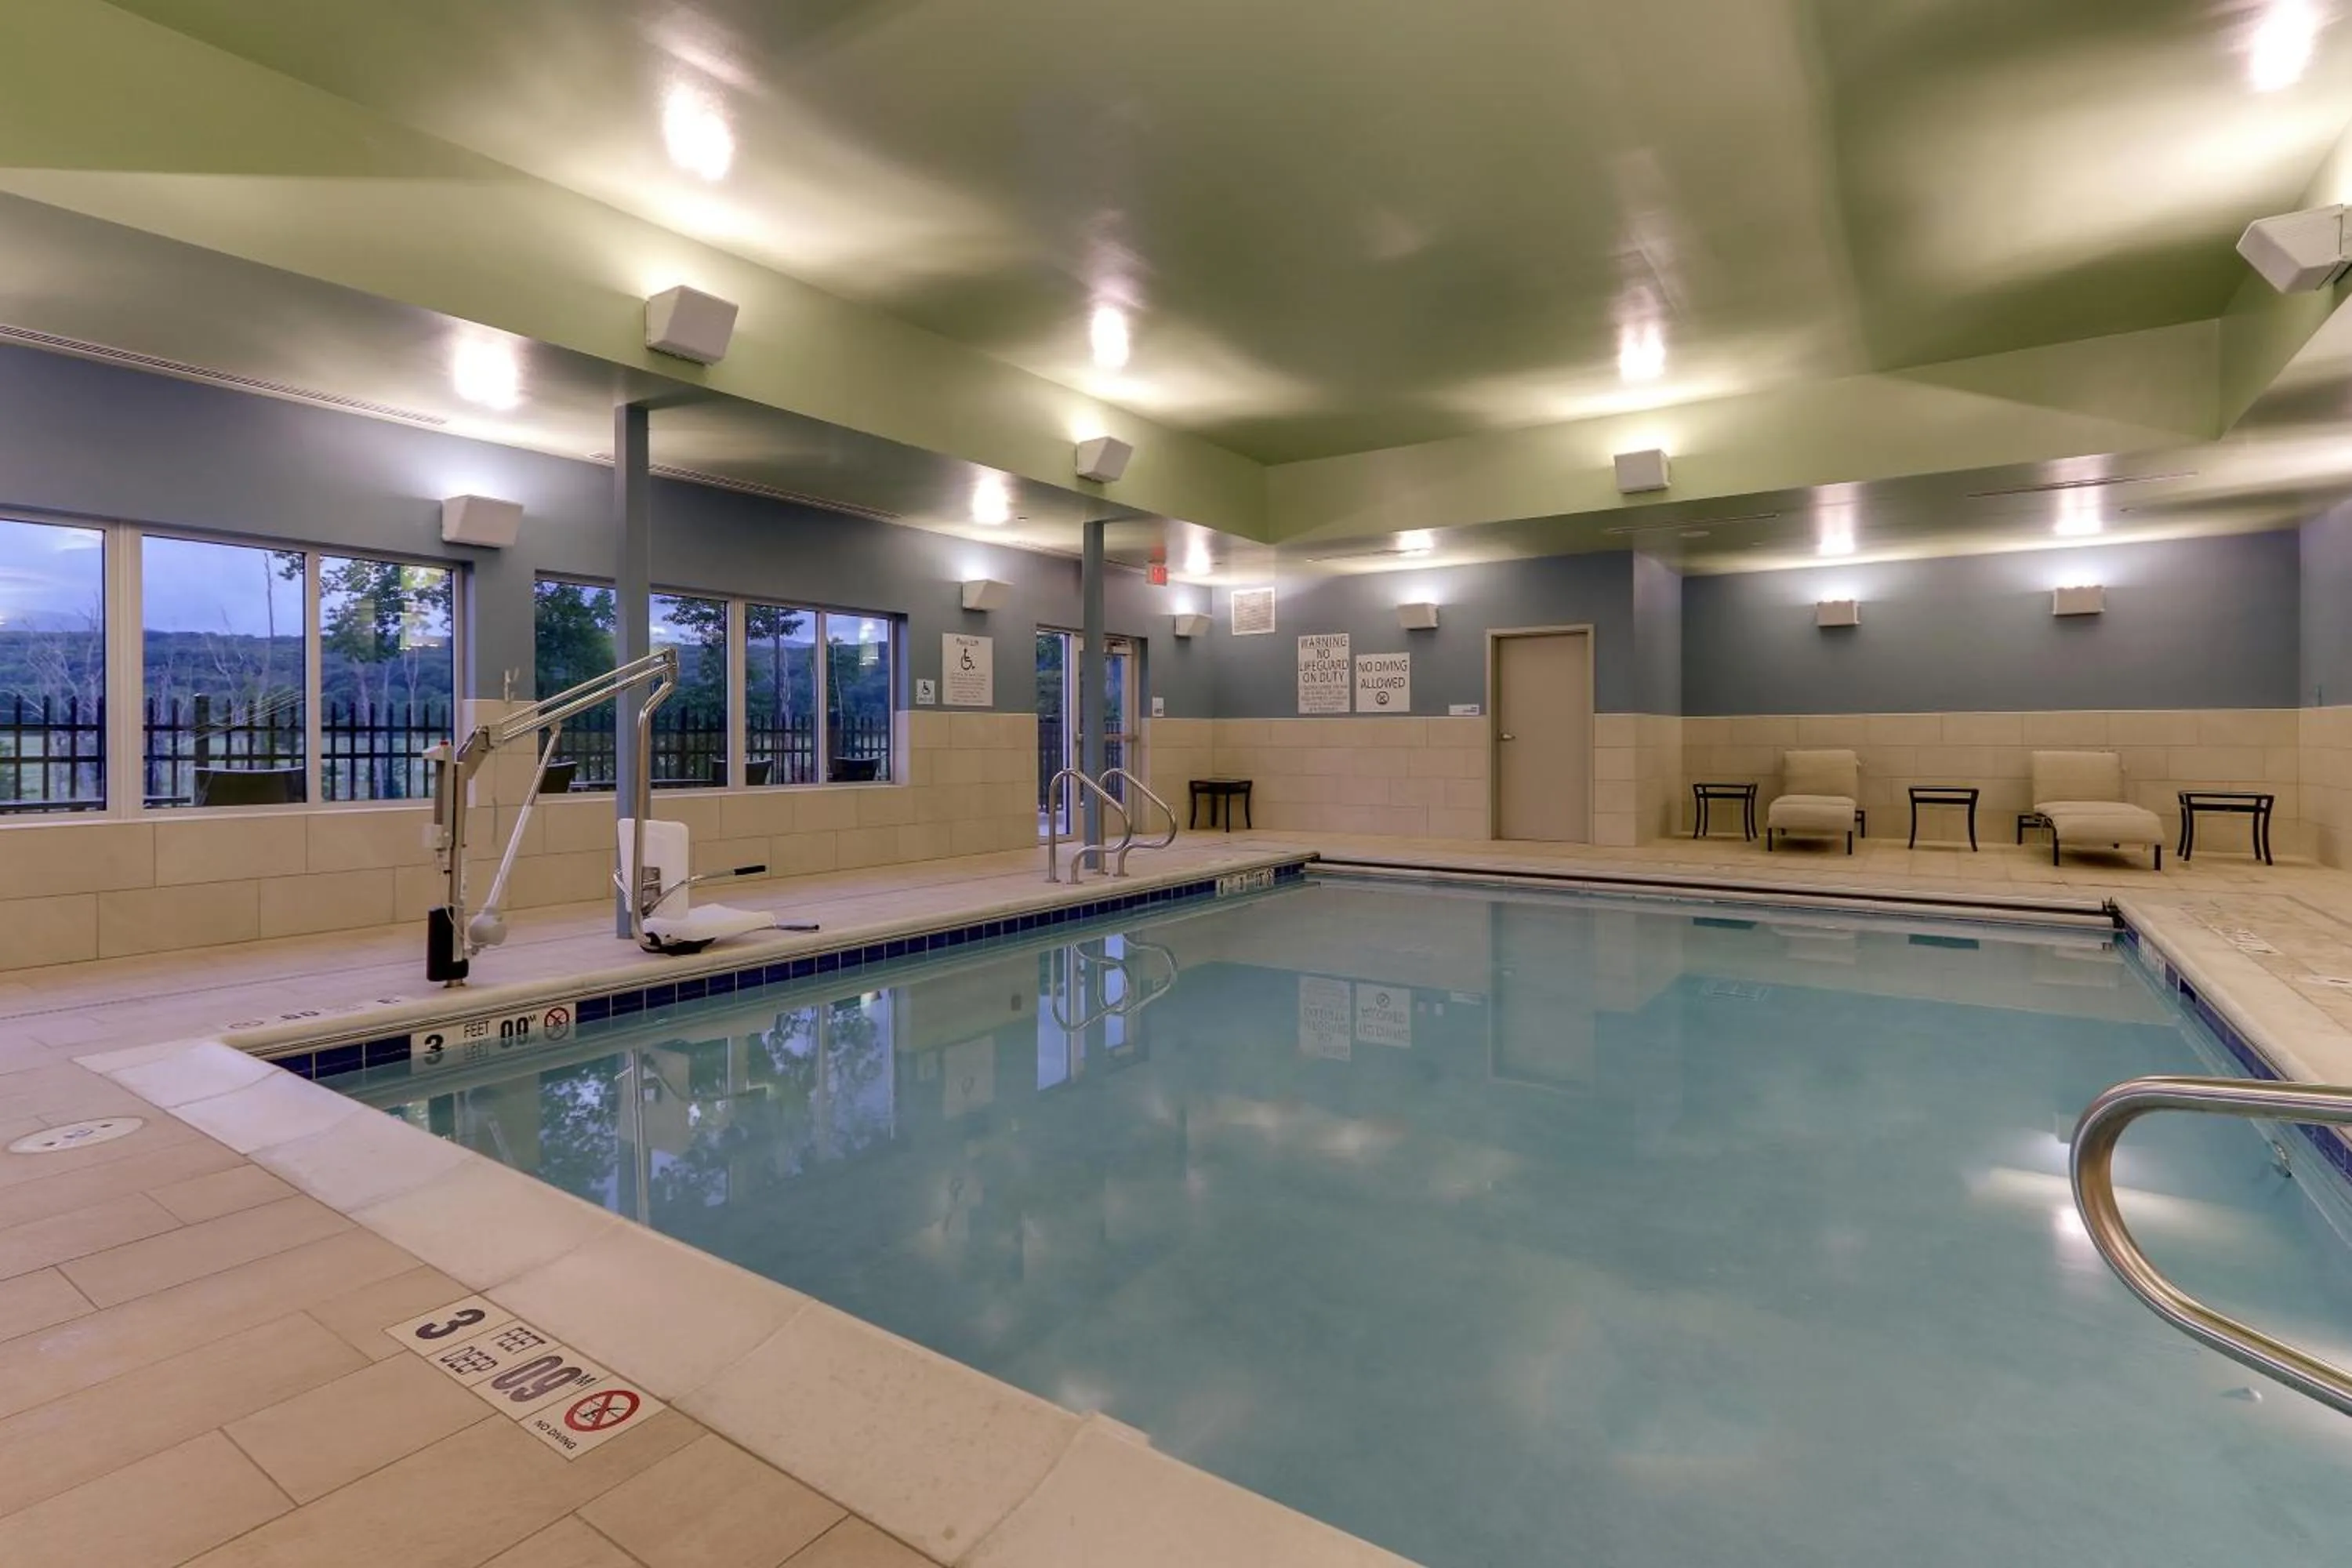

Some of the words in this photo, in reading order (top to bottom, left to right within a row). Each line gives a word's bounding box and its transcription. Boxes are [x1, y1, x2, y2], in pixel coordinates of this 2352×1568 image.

[1316, 648, 1330, 659] NO
[1299, 659, 1348, 672] LIFEGUARD
[1358, 661, 1372, 673] NO
[1374, 659, 1407, 672] DIVING
[1303, 672, 1316, 683] ON
[1319, 671, 1345, 683] DUTY
[1360, 677, 1406, 689] ALLOWED
[424, 1033, 445, 1054] 3
[464, 1021, 490, 1039] FEET
[416, 1308, 485, 1340] 3
[490, 1327, 546, 1356] FEET
[439, 1346, 499, 1375] DEEP
[535, 1420, 550, 1432] NO
[547, 1428, 577, 1450] DIVING
